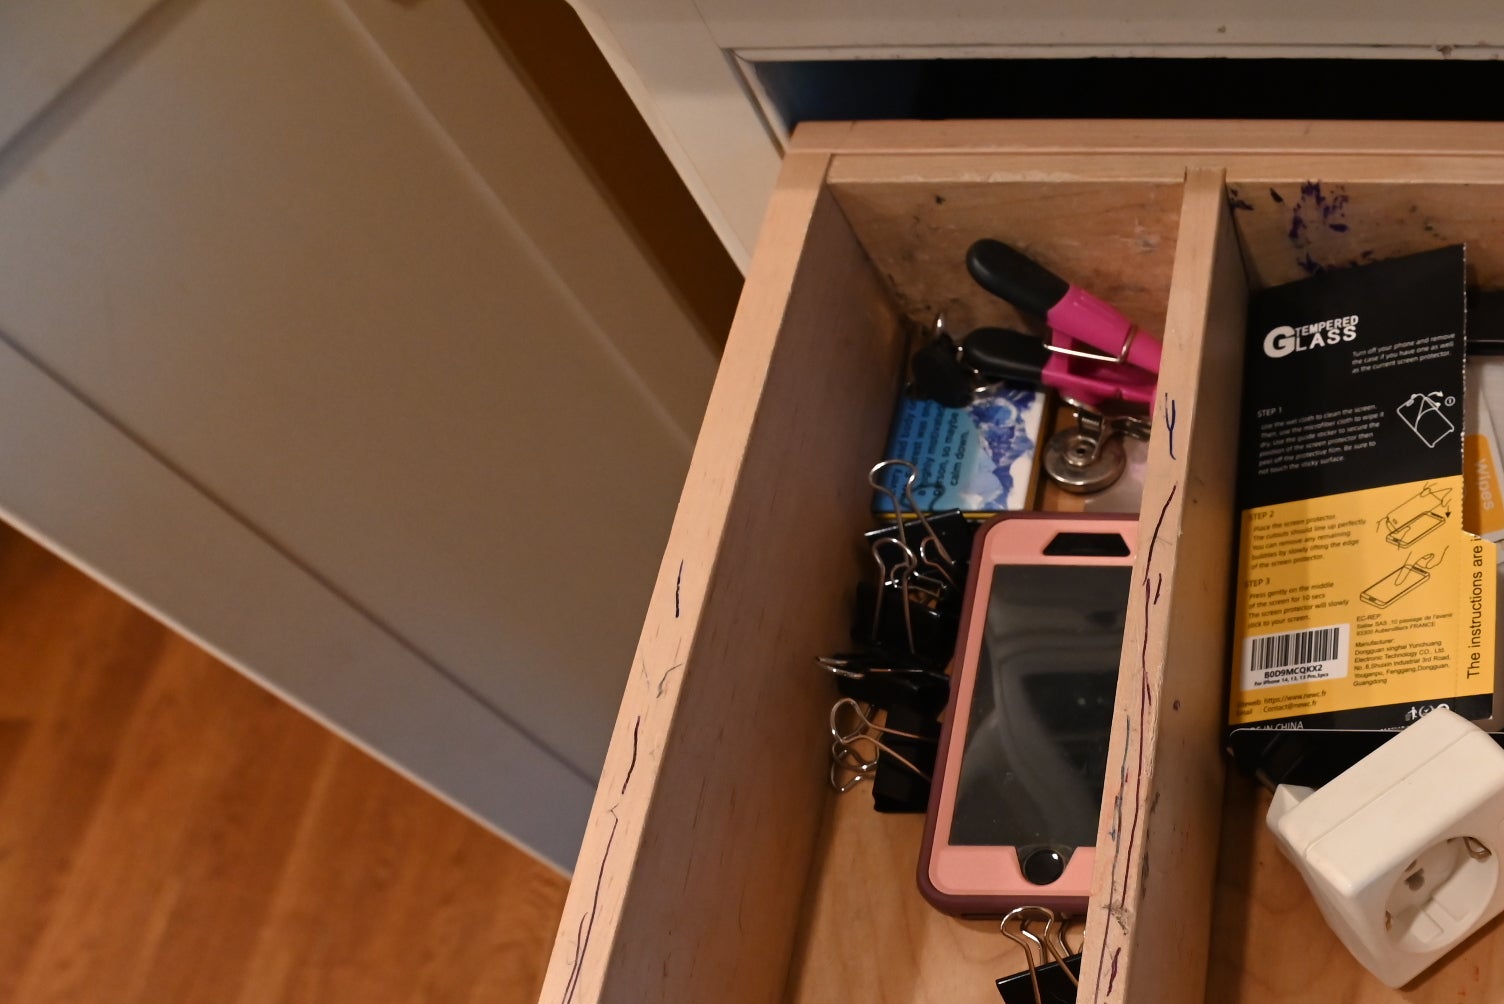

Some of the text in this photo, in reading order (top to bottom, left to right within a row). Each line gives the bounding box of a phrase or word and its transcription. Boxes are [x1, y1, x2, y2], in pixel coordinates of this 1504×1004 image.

[1295, 315, 1359, 335] TEMPERED
[1263, 325, 1357, 358] GLASS
[1467, 546, 1482, 679] The instructions are
[1264, 665, 1322, 678] B0D9MCQKX2
